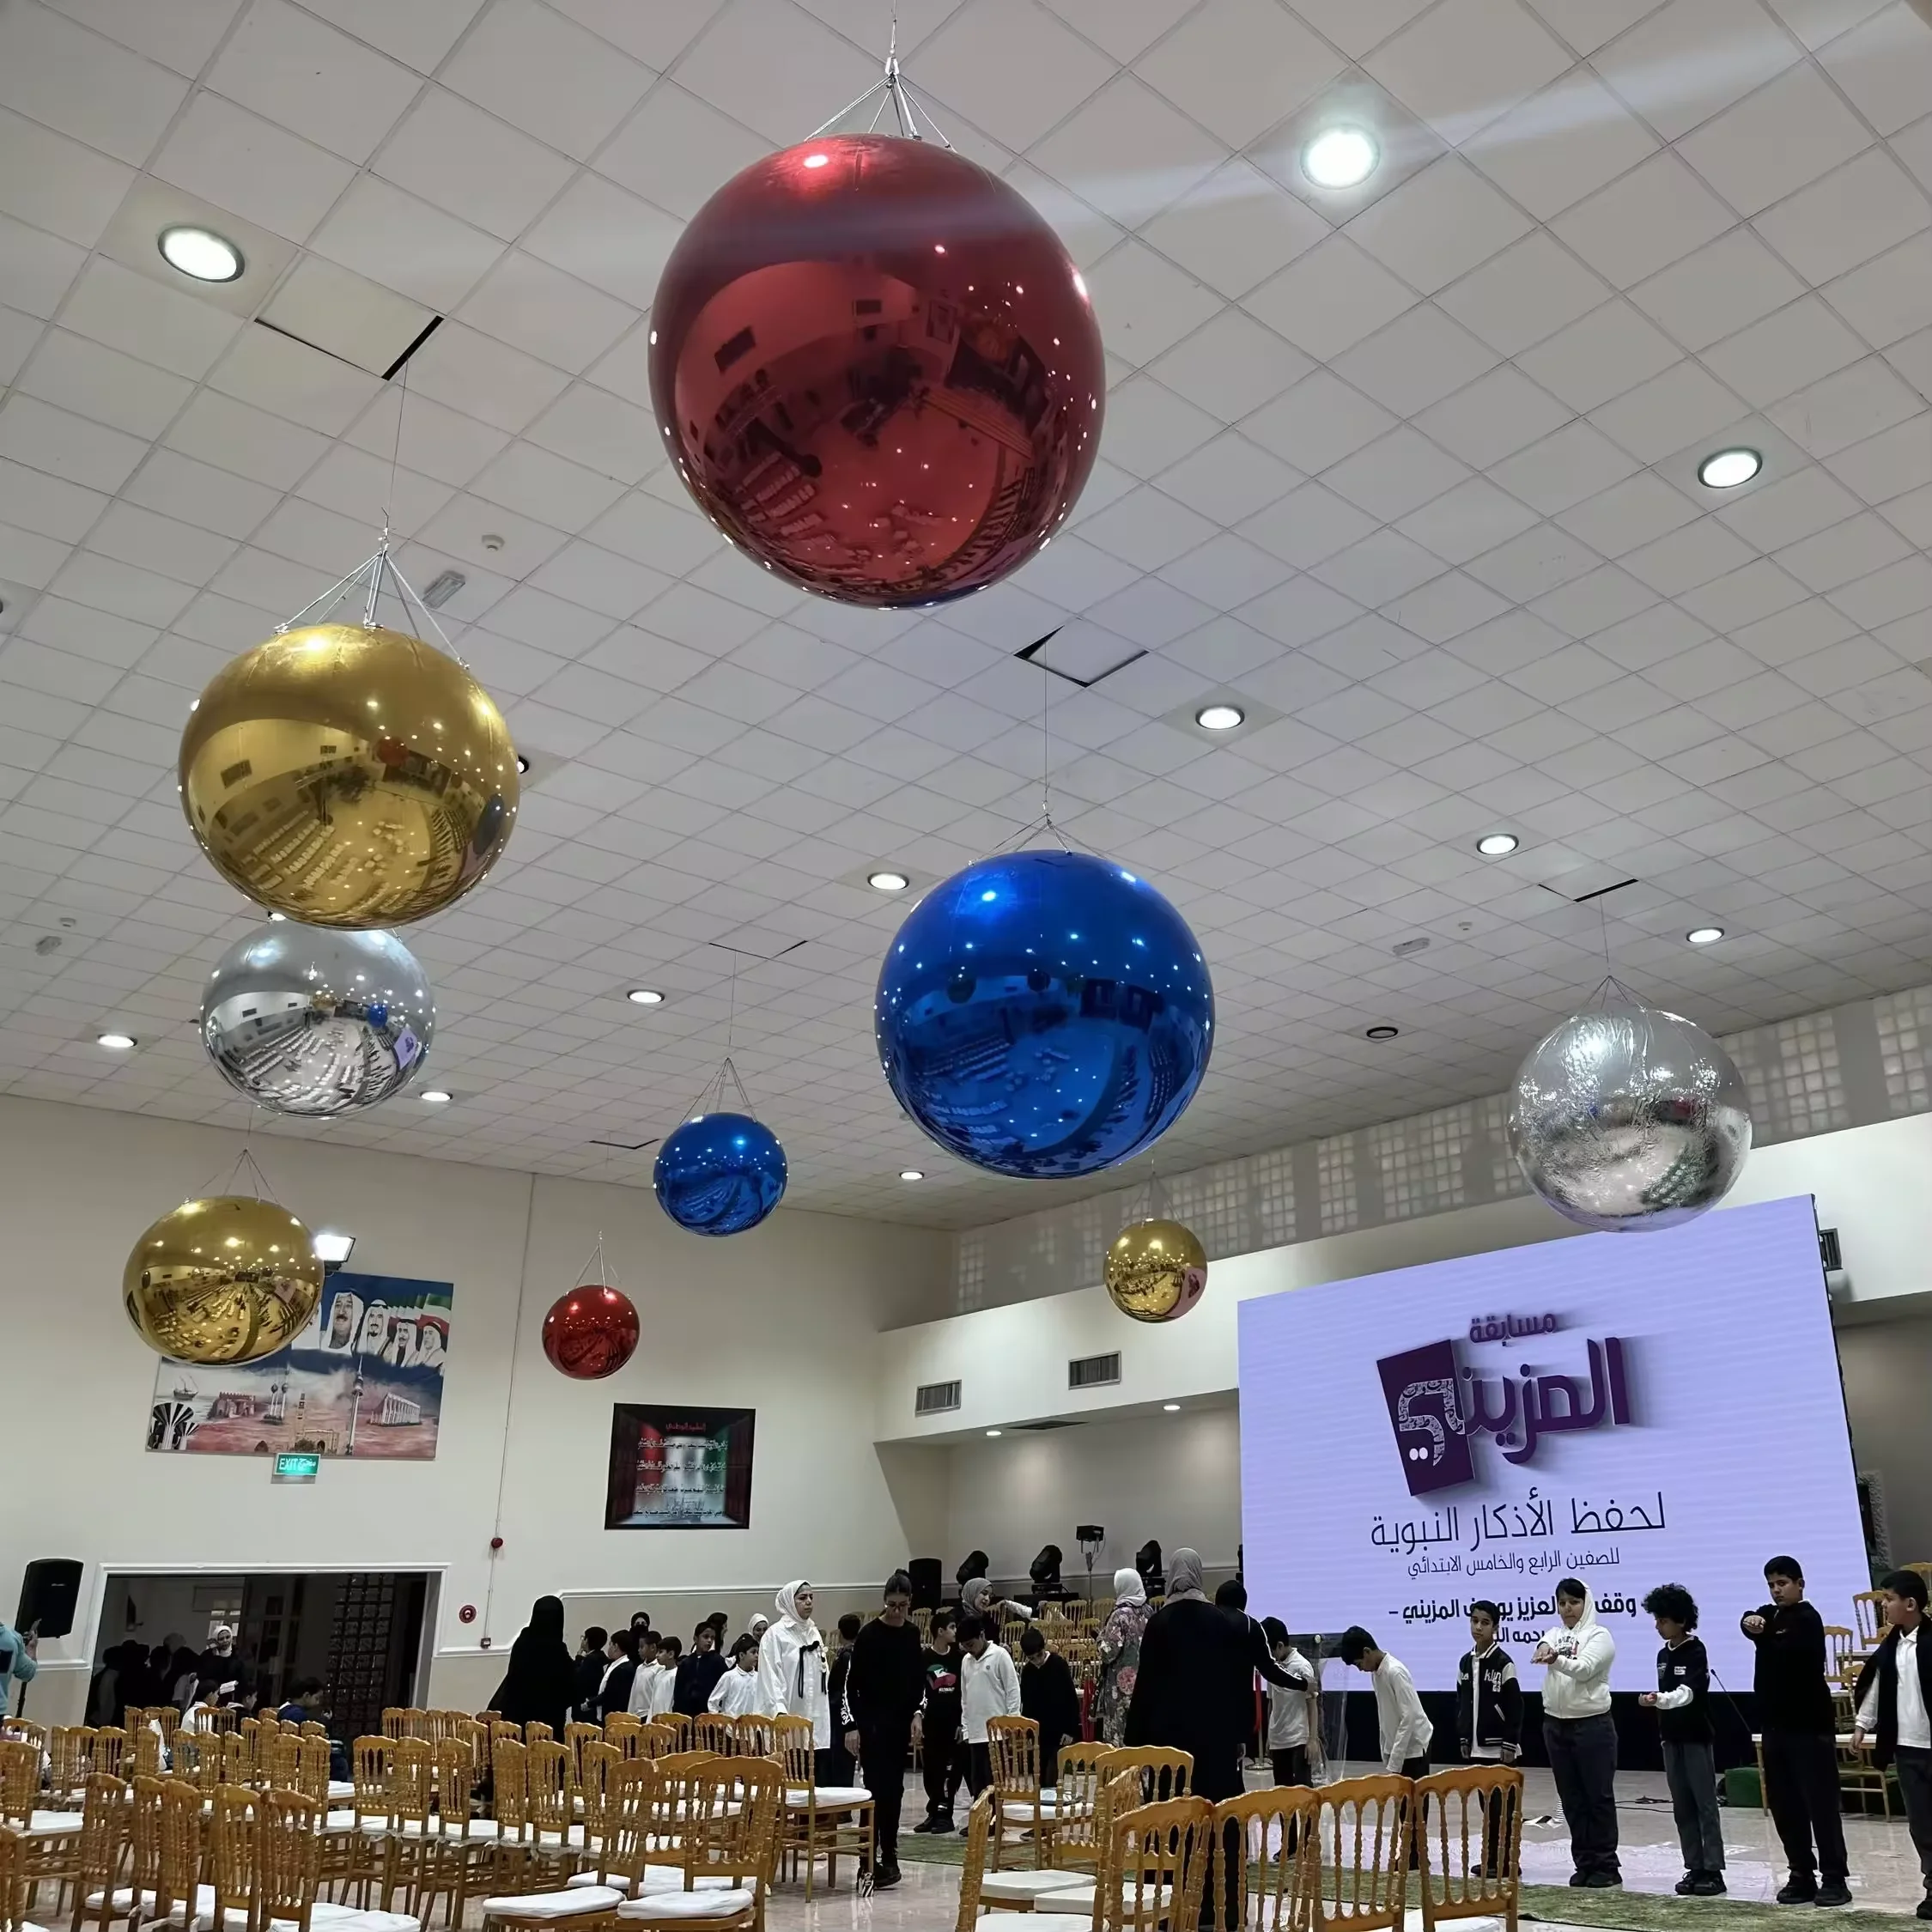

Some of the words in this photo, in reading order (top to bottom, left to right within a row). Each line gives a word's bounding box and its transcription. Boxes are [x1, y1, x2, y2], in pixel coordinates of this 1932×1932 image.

[1469, 1314, 1557, 1347] مسابقة
[1397, 1336, 1630, 1467] المزيني
[279, 1458, 299, 1471] EXIT
[1469, 1486, 1555, 1552] الأذكار
[1571, 1492, 1666, 1534] لحفظ
[1371, 1506, 1460, 1555] النبوية
[1407, 1555, 1461, 1581] الابتدائي
[1467, 1552, 1524, 1576] والخامس
[1528, 1550, 1561, 1575] الرابع
[1565, 1547, 1620, 1570] للصفين
[1402, 1598, 1460, 1625] المزيني
[1516, 1595, 1560, 1622] لعزيز
[1595, 1592, 1637, 1618] وقف
